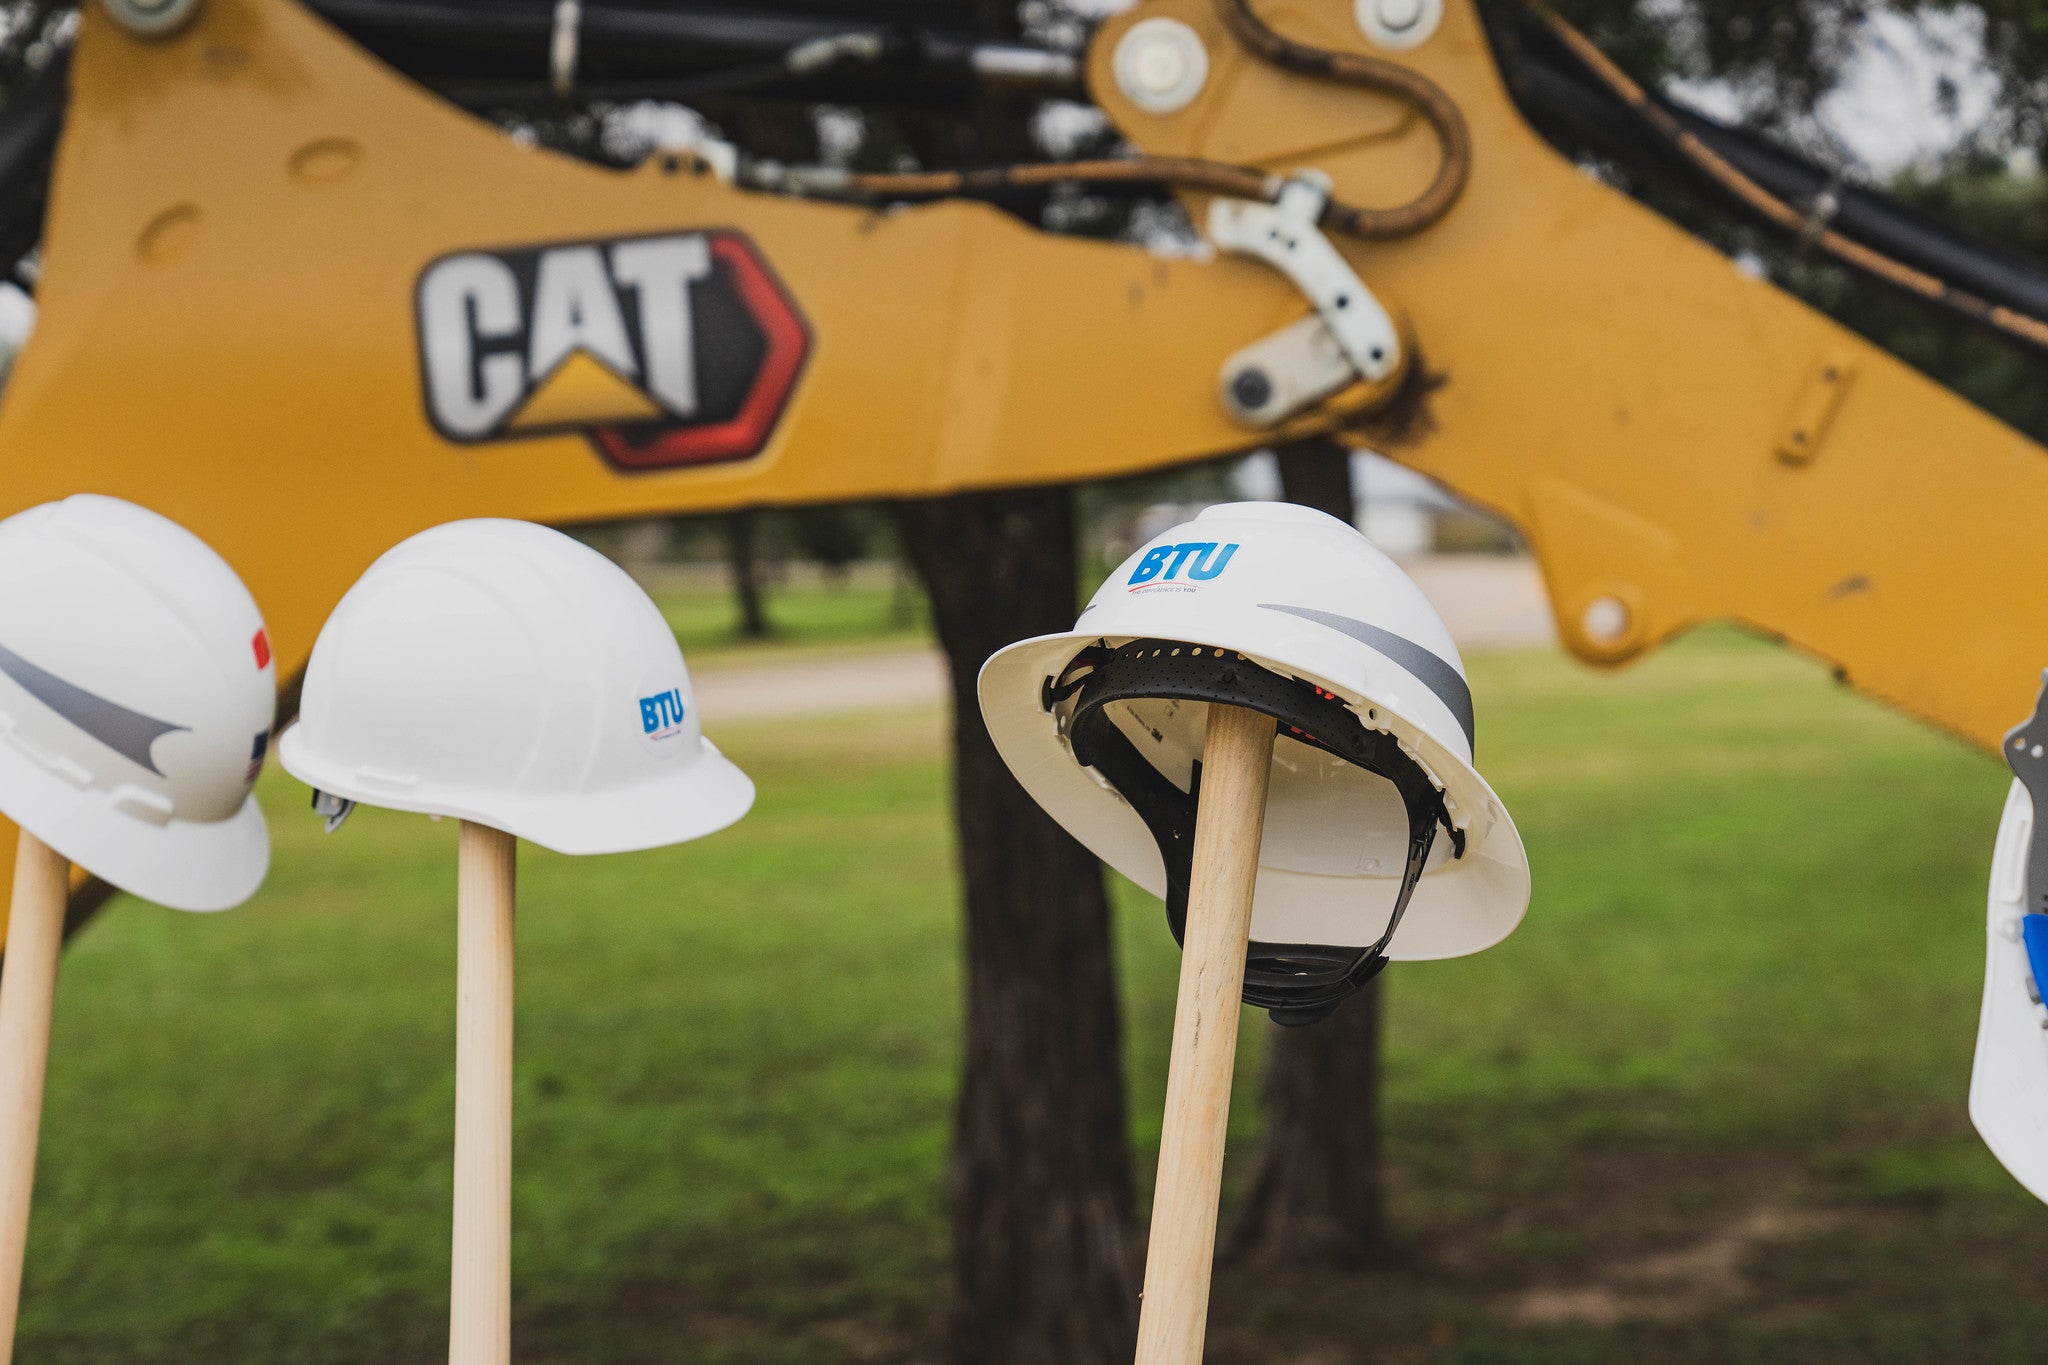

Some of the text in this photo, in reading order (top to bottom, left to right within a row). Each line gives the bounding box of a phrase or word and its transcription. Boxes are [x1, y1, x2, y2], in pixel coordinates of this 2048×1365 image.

[419, 233, 712, 438] CAT
[1127, 542, 1240, 586] BTU
[1141, 587, 1174, 595] DIFFERENCE
[639, 688, 684, 734] BTU
